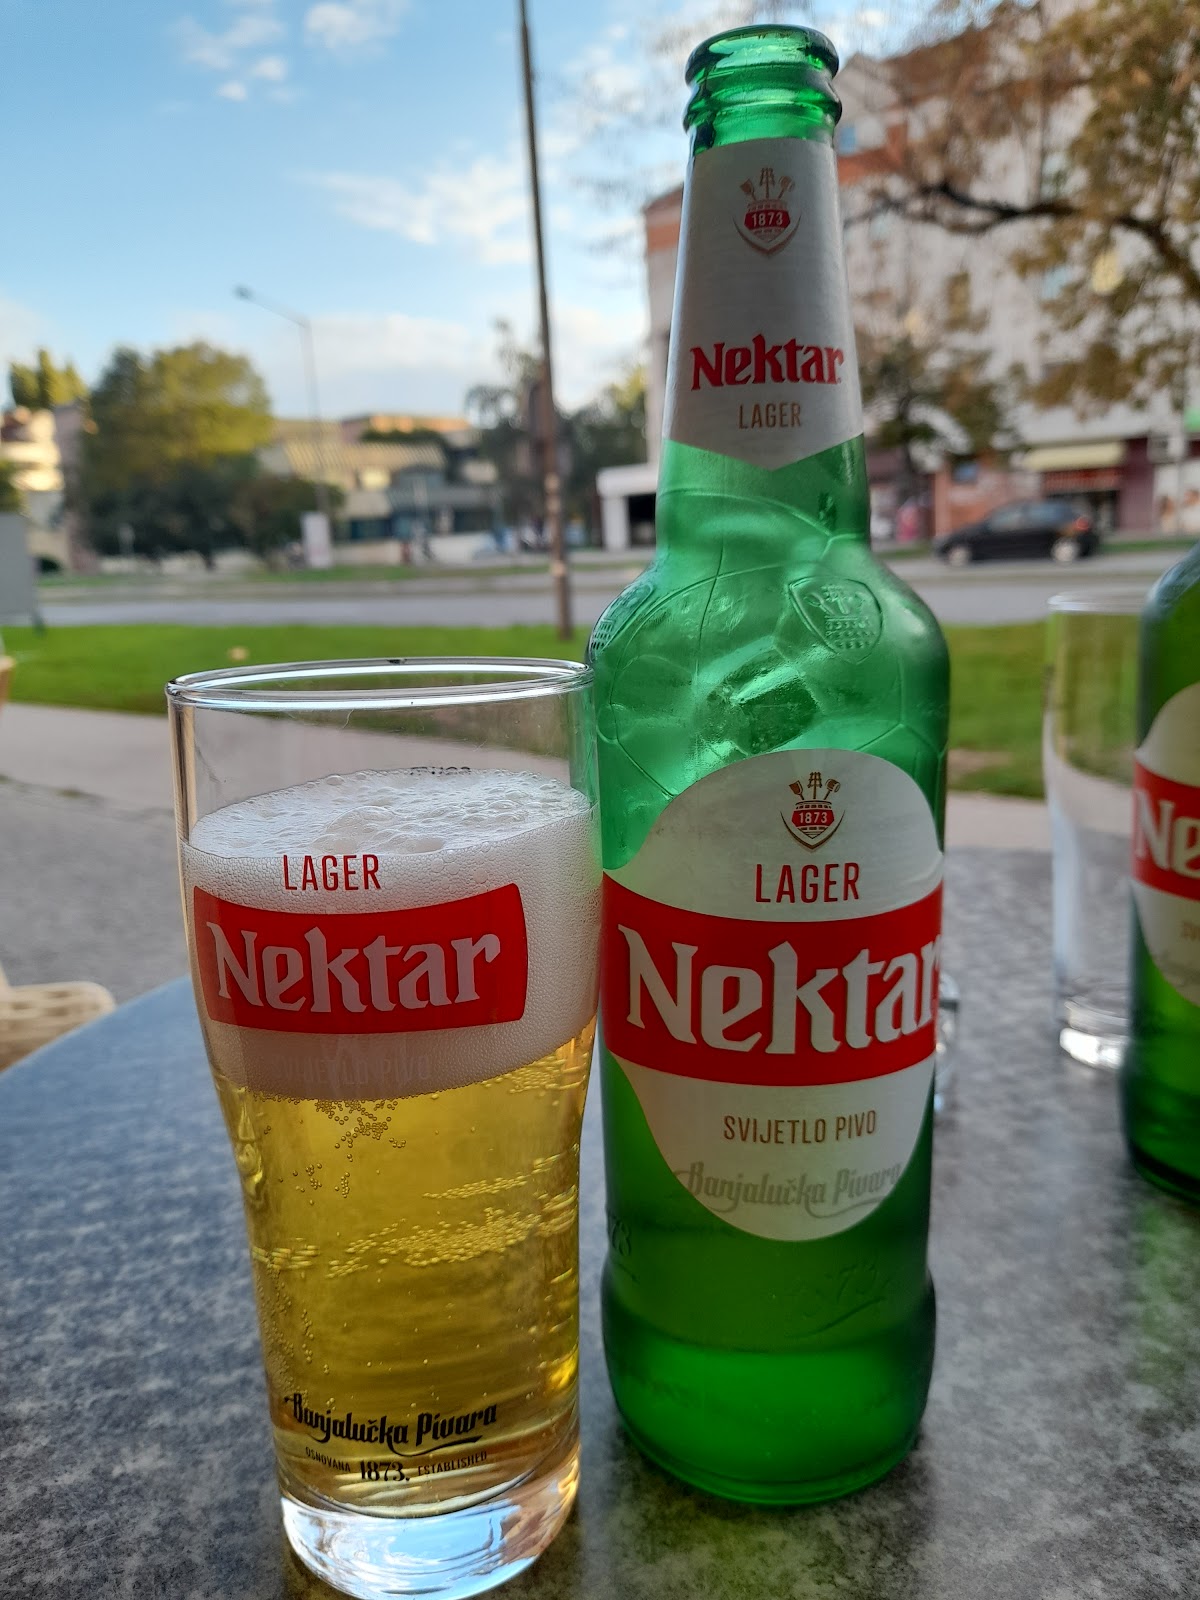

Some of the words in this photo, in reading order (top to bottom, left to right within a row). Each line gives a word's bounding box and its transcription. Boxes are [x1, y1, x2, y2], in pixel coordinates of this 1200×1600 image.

[751, 212, 784, 226] 1873
[690, 333, 845, 391] Nektar
[738, 402, 801, 430] LAGER
[798, 811, 828, 825] 1873
[283, 853, 382, 891] LAGER
[755, 862, 860, 904] LAGER
[206, 921, 501, 1014] Nektar
[617, 924, 943, 1055] Nektar
[723, 1114, 827, 1145] SVIJETLO
[835, 1109, 877, 1141] PIVO
[675, 1160, 826, 1215] Banjalučka
[284, 1392, 409, 1452] Banjalučka
[415, 1403, 498, 1447] Pivara
[305, 1446, 351, 1472] OSNOVANA
[359, 1459, 411, 1482] 1873.
[417, 1451, 488, 1477] ESTABLISHED
